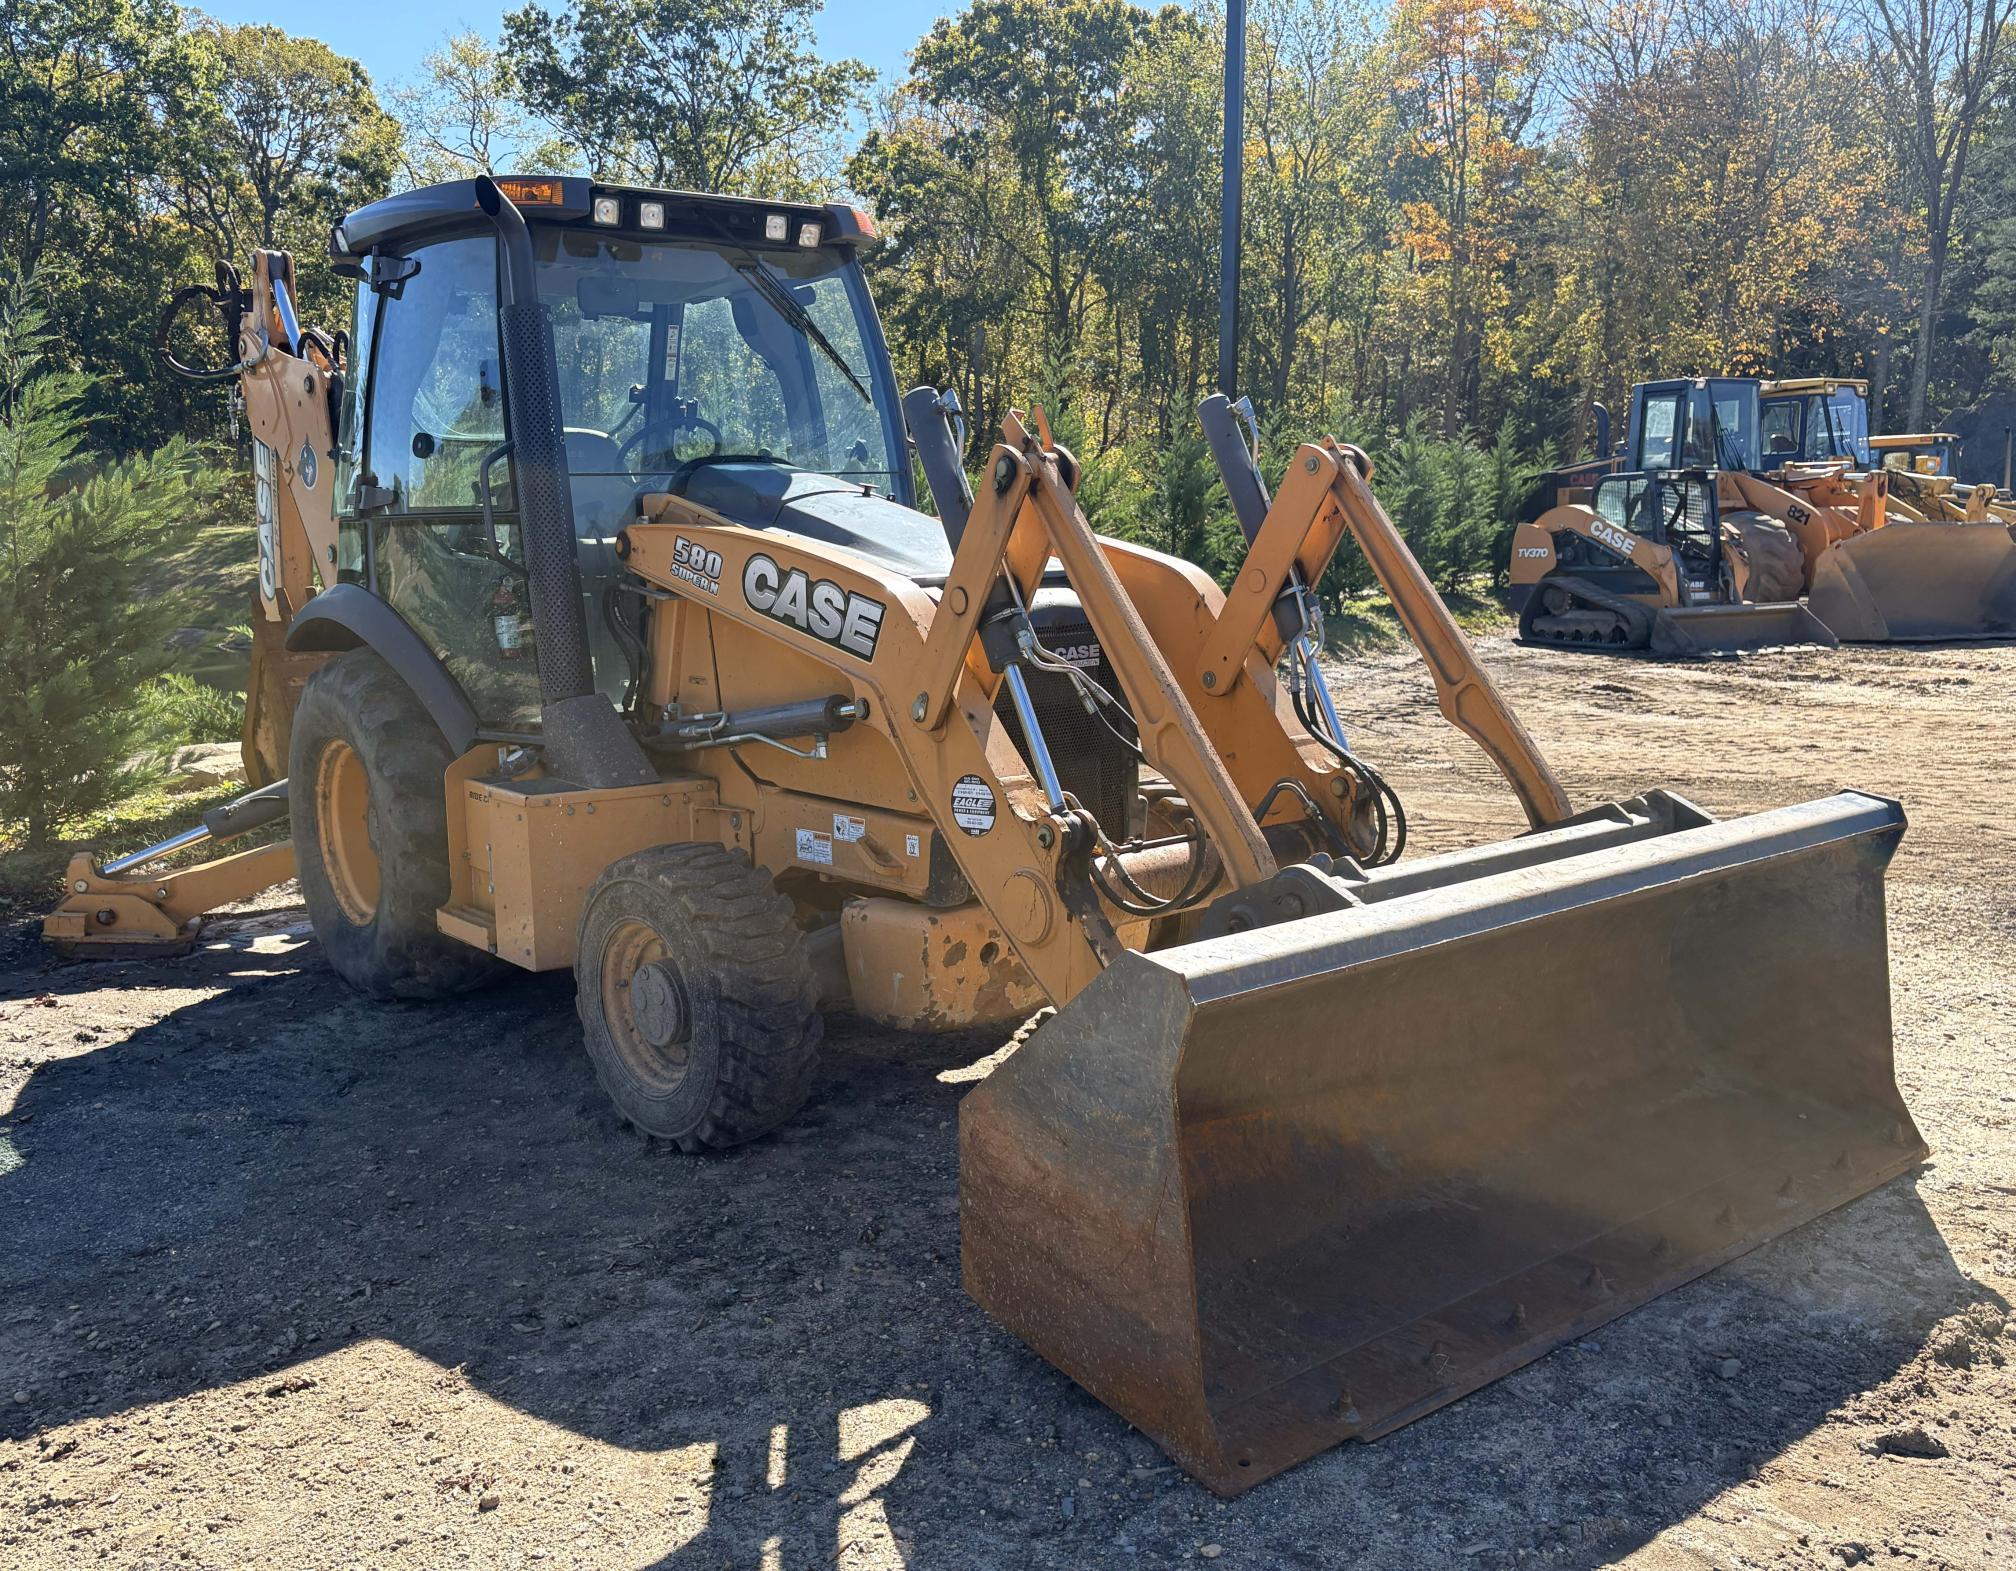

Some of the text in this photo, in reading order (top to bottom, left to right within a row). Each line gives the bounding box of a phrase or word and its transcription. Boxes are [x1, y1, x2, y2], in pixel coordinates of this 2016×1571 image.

[254, 438, 276, 601] CASE
[1787, 504, 1811, 526] 821
[1518, 548, 1549, 558] TV370
[1590, 520, 1636, 555] CASE
[674, 536, 723, 579] 580
[670, 562, 719, 596] SUPER N
[743, 554, 886, 661] CASE
[1055, 644, 1099, 660] CASE
[953, 797, 993, 807] EAGLE
